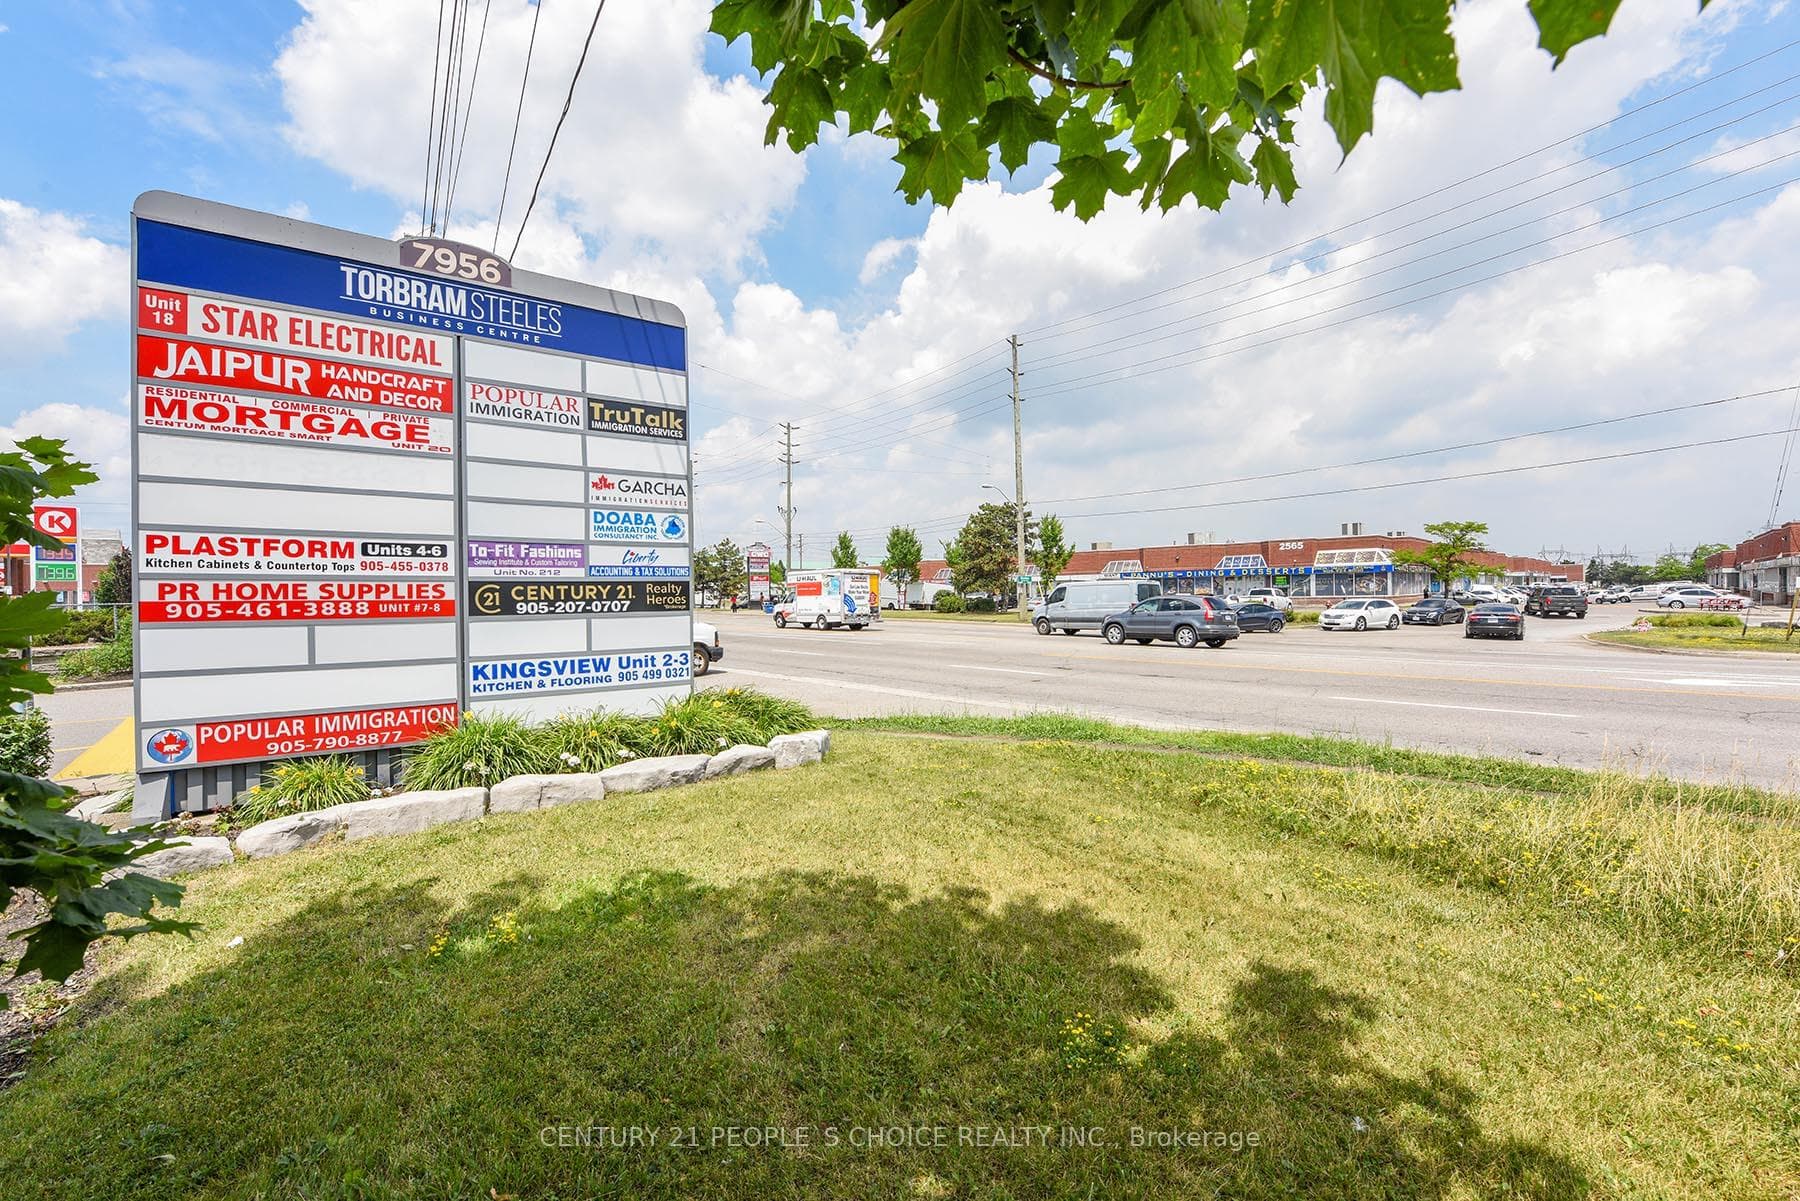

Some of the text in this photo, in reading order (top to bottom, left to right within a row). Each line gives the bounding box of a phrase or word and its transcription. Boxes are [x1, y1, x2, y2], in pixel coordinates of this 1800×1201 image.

[412, 242, 501, 284] 7956
[145, 294, 182, 312] Unit
[152, 311, 174, 326] 18
[369, 306, 541, 344] BUSINESS CENTRE
[201, 303, 442, 367] STAR ELECTRICAL
[152, 342, 312, 396] JAIPUR
[321, 363, 447, 394] HANDCRAFT
[145, 386, 430, 425] RESIDENTIAL COMMERCIAL PRIVATE
[326, 383, 443, 411] AND DECOR
[470, 383, 580, 414] POPULAR
[144, 395, 430, 444] MORTGAGE
[469, 401, 580, 426] IMMIGRATION
[589, 401, 684, 430] TruTalk
[144, 418, 332, 442] CENTUM MORTGAGE SMART
[591, 420, 684, 439] IMMIGRATION SERVICES
[391, 442, 451, 453] UNIT 20
[617, 479, 687, 497] GARCHA
[47, 515, 68, 532] K
[593, 511, 656, 526] DOABA
[593, 525, 657, 534] IMMIGRATION
[593, 532, 644, 540] CONSULTANCY
[145, 534, 355, 559] PLASTFORM
[367, 543, 442, 557] Units 4-6
[469, 543, 582, 558] To-Fit Fashions
[1279, 541, 1304, 550] 2565
[145, 557, 355, 573] Kitchen Cabinets & Countertop Tops
[474, 558, 497, 567] Sewing
[498, 558, 523, 566] Institute
[622, 548, 660, 565] Liberty
[360, 560, 449, 572] 905-455-0378
[591, 566, 689, 576] ACCOUNTING & TAX SOLUTIONS
[1186, 568, 1224, 577] DINING
[1229, 568, 1236, 576] &
[1241, 566, 1305, 576] DESSERTS
[157, 582, 446, 600] PR HOME SUPPLIES
[511, 585, 611, 601] CENTURY
[646, 583, 682, 596] Realty
[516, 600, 631, 614] 905-207-0707
[646, 594, 687, 605] Heroes
[165, 601, 441, 619] 905-461-3888 UNIT #7-8
[472, 652, 689, 681] KINGSVIEW Unit 2-3
[617, 667, 690, 682] 905 499 0321
[472, 674, 612, 693] KITCHEN & FLOORING
[200, 706, 455, 745] POPULAR IMMIGRATION
[266, 730, 403, 755] 905-790-8877
